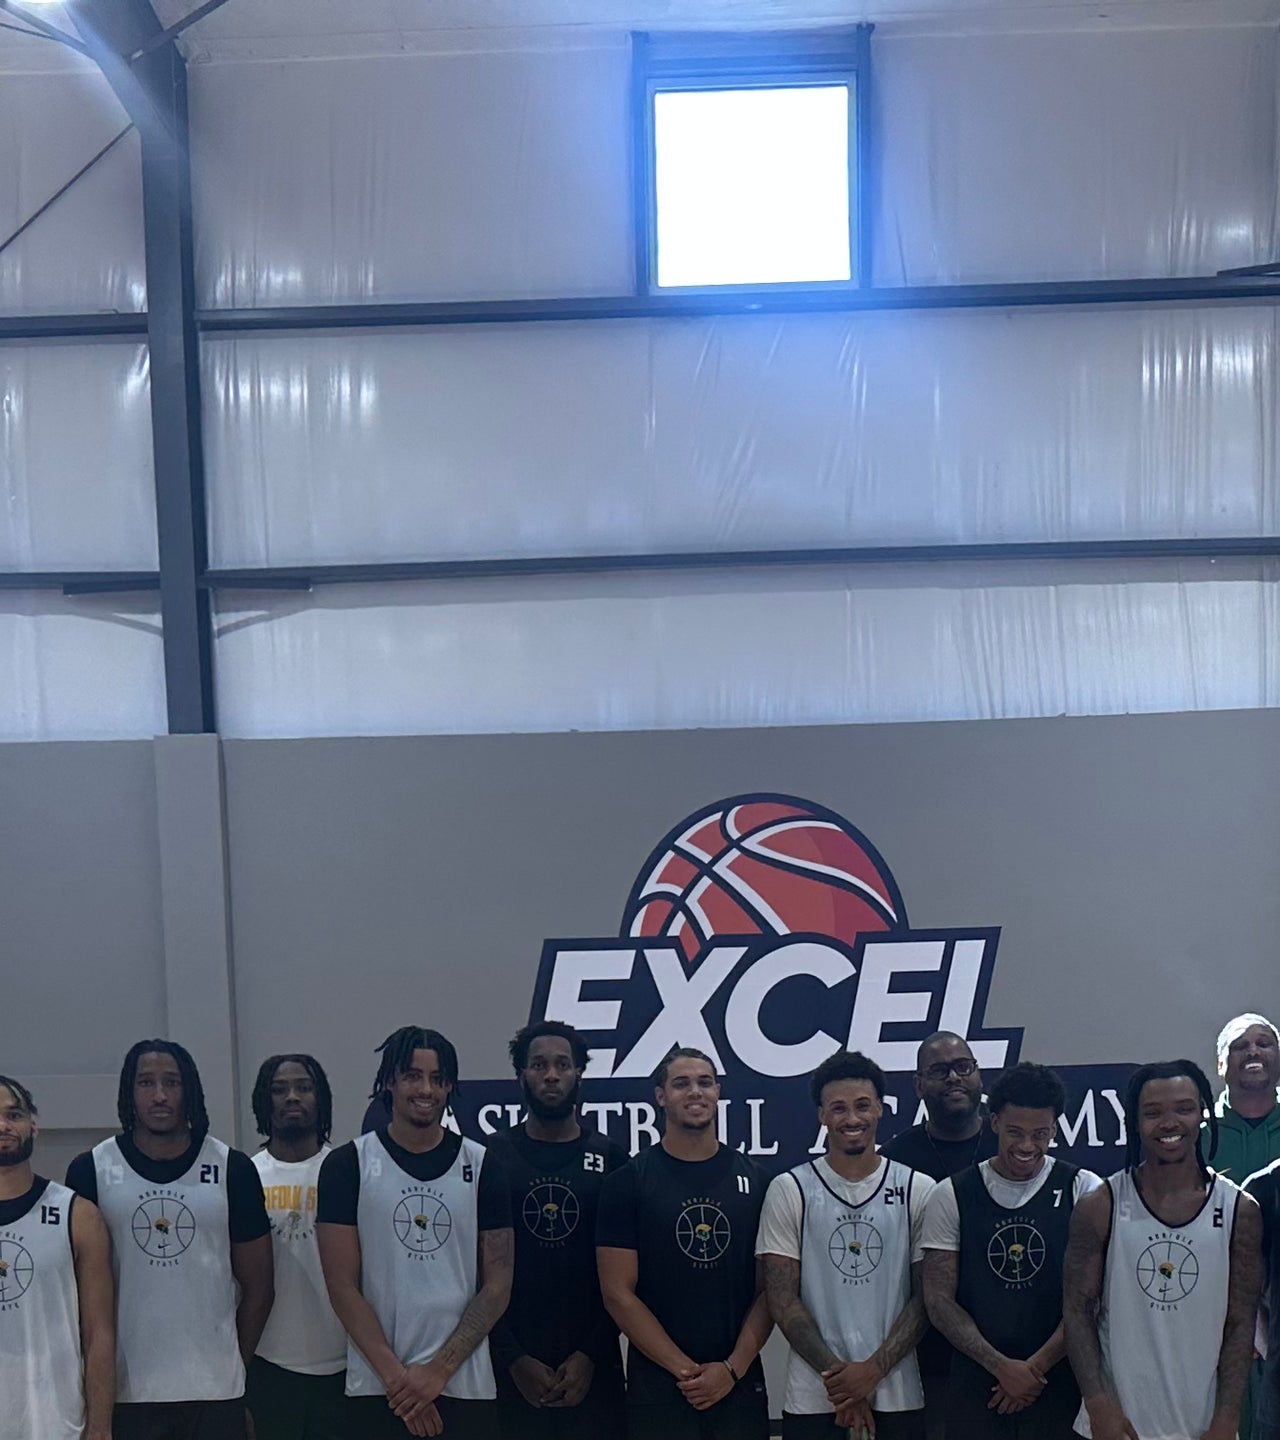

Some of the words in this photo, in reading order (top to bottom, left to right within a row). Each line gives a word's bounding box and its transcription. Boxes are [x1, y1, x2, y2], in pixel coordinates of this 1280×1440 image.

[544, 939, 1010, 1079] EXCEL
[583, 1152, 604, 1173] 23
[200, 1164, 219, 1184] 21
[462, 1164, 473, 1183] 6
[736, 1175, 750, 1194] 11
[884, 1186, 905, 1205] 24
[1053, 1189, 1063, 1208] 7
[41, 1205, 61, 1225] 15
[1213, 1207, 1223, 1228] 2
